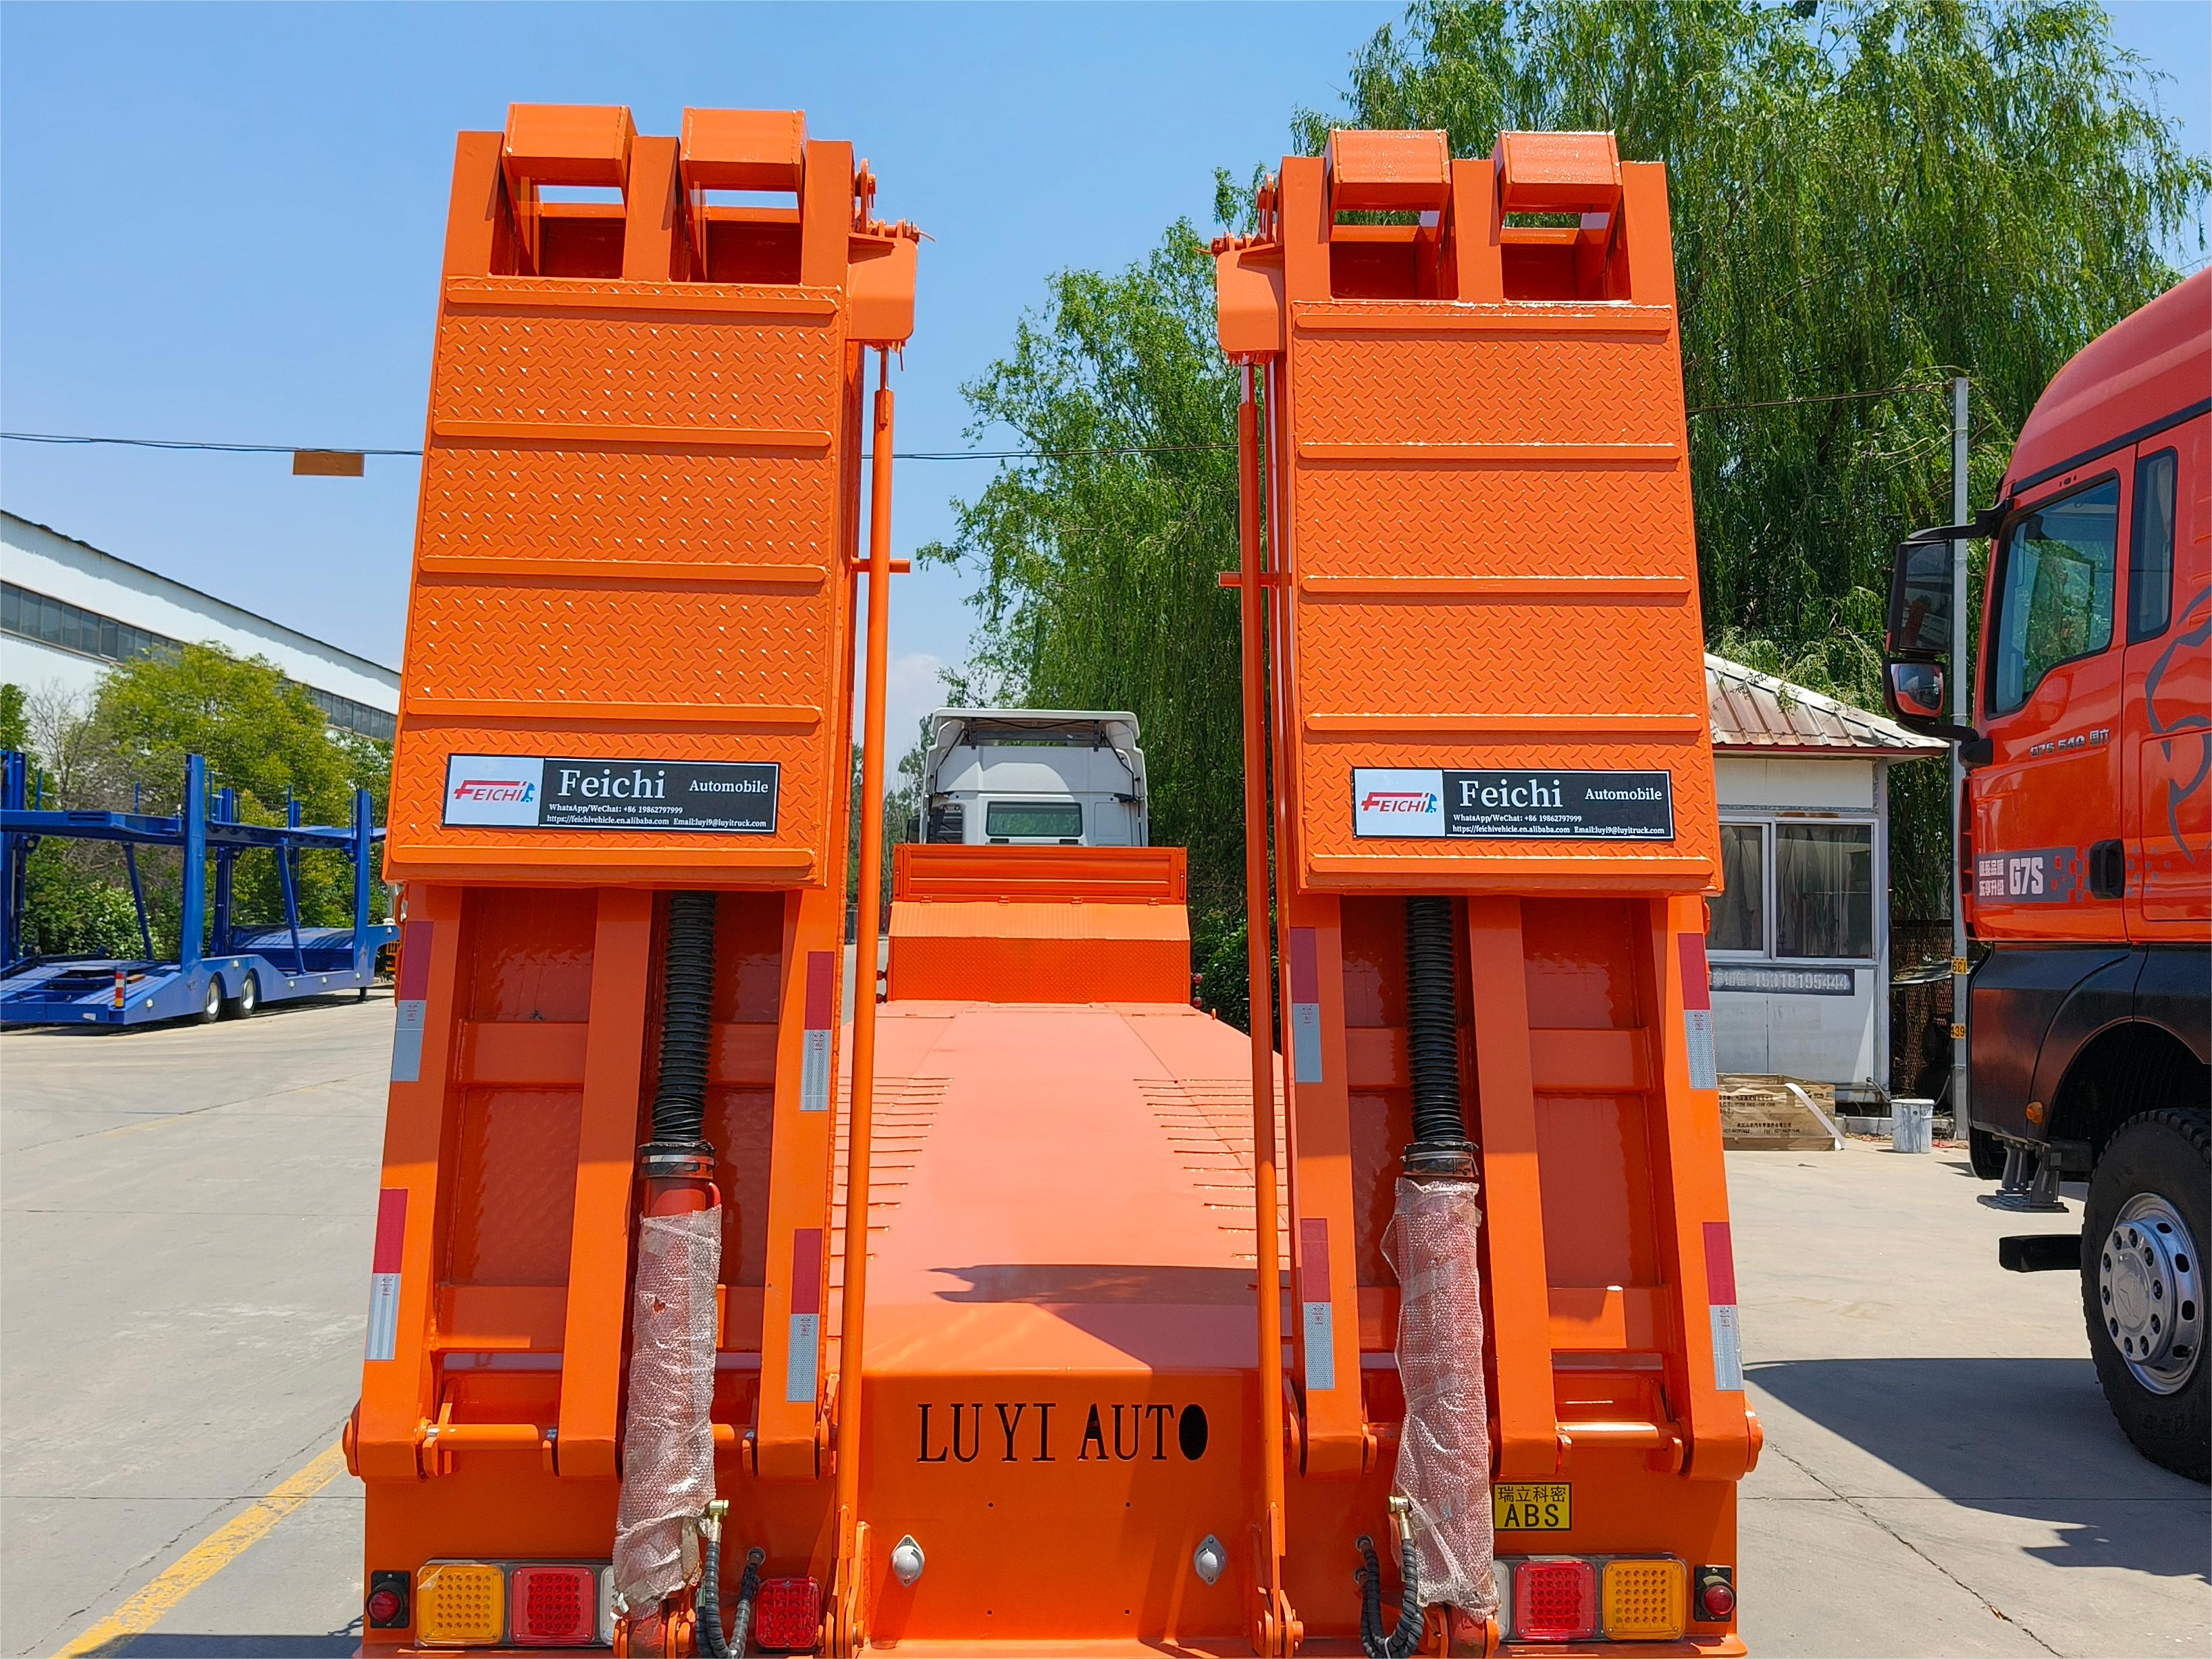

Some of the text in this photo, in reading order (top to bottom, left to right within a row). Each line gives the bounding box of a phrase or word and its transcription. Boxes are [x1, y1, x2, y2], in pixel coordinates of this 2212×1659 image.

[557, 768, 768, 799] Feichi Automobile
[1458, 779, 1662, 808] Feichi Automobile
[549, 804, 622, 813] WhatsApp/WeChat:
[638, 806, 683, 814] 19862797999
[1453, 814, 1523, 823] WhatsApp/WeChat:
[1539, 814, 1582, 822] 19862797999
[2009, 857, 2043, 895] G7S
[916, 1402, 1209, 1463] LUYI AUTO
[1498, 1485, 1566, 1503] 瑞立科密
[1504, 1504, 1559, 1527] ABS
